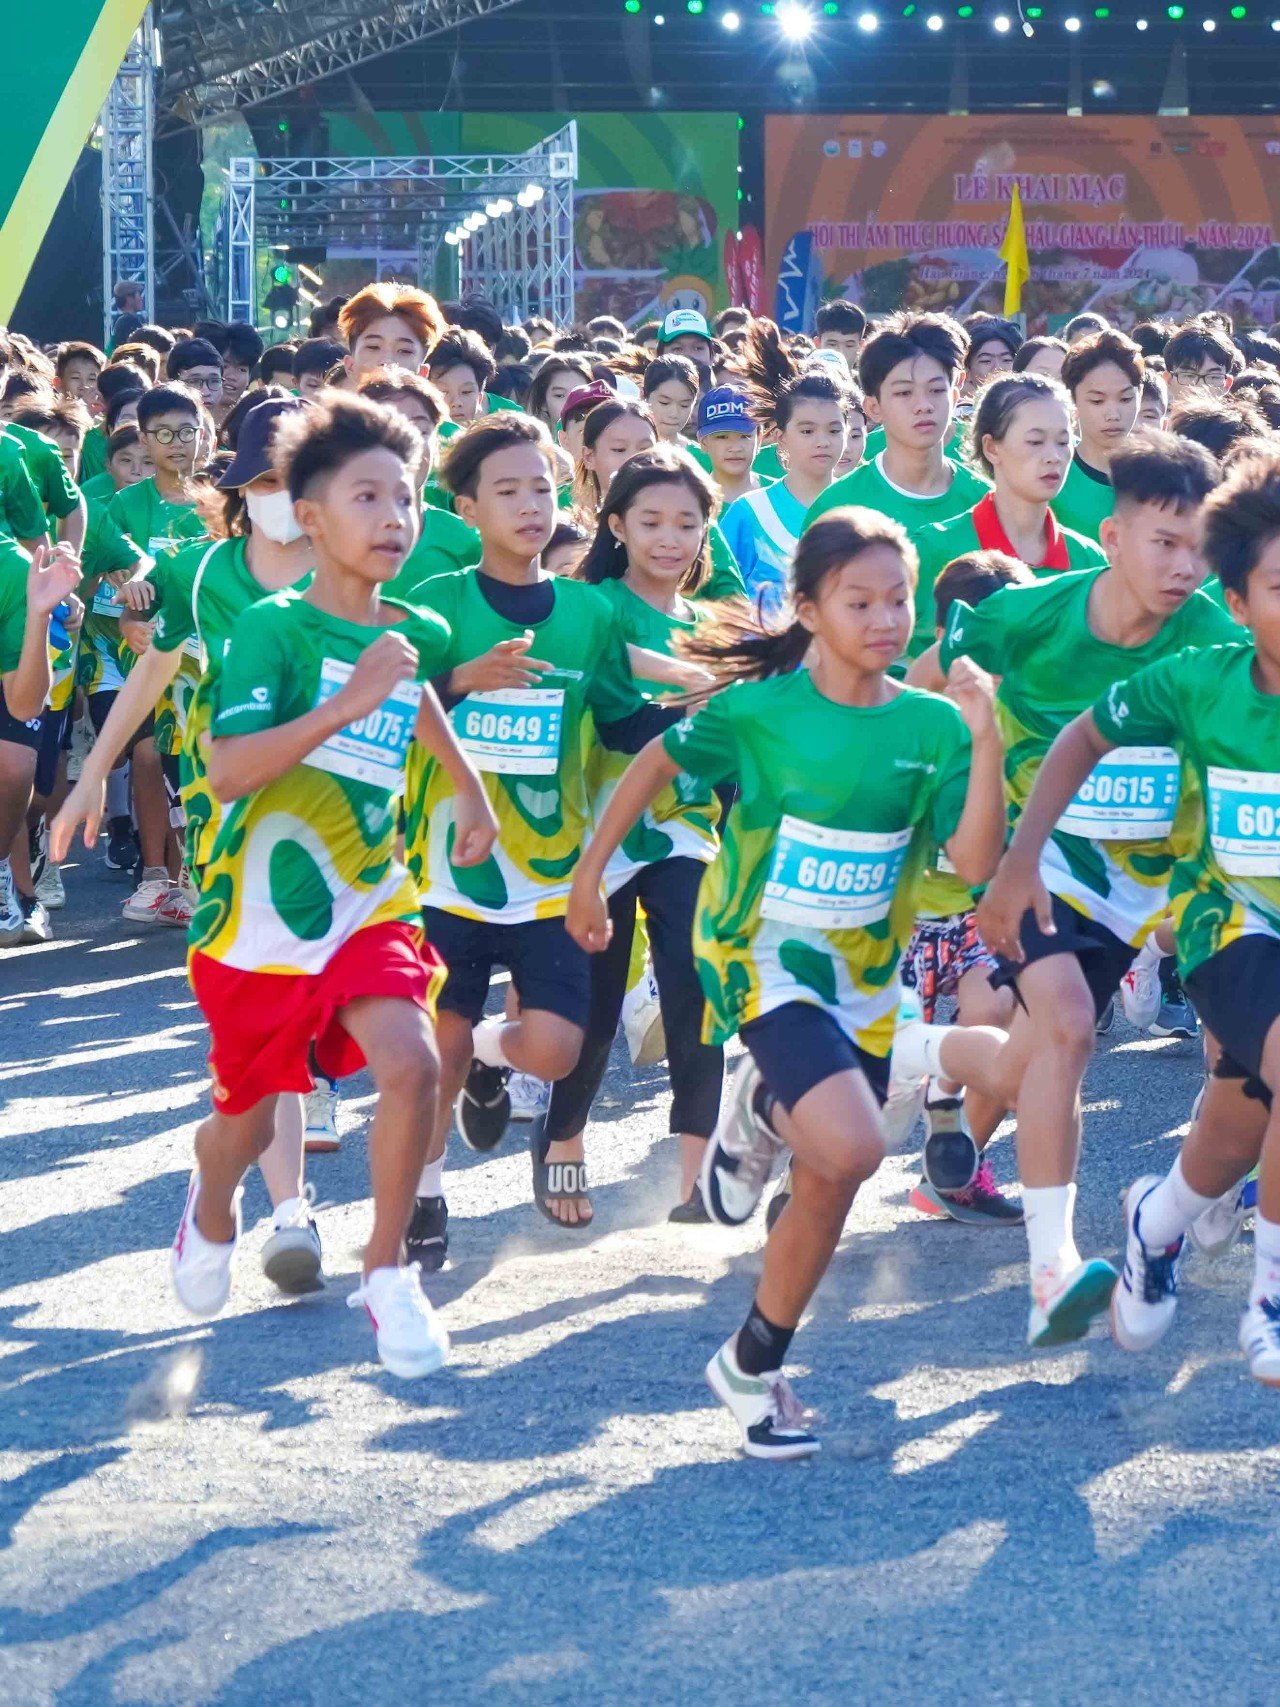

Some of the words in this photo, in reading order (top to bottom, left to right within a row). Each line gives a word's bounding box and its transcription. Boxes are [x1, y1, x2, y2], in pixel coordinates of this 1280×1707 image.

[995, 175, 1060, 200] KHAI
[1067, 174, 1126, 206] MẠC
[839, 222, 861, 247] THI
[1059, 222, 1107, 248] GIANG
[1236, 223, 1271, 248] 2024
[707, 402, 744, 418] DDM
[350, 709, 404, 746] 0075
[465, 711, 542, 742] 60649
[1078, 774, 1155, 805] 60615
[797, 856, 887, 892] 60659
